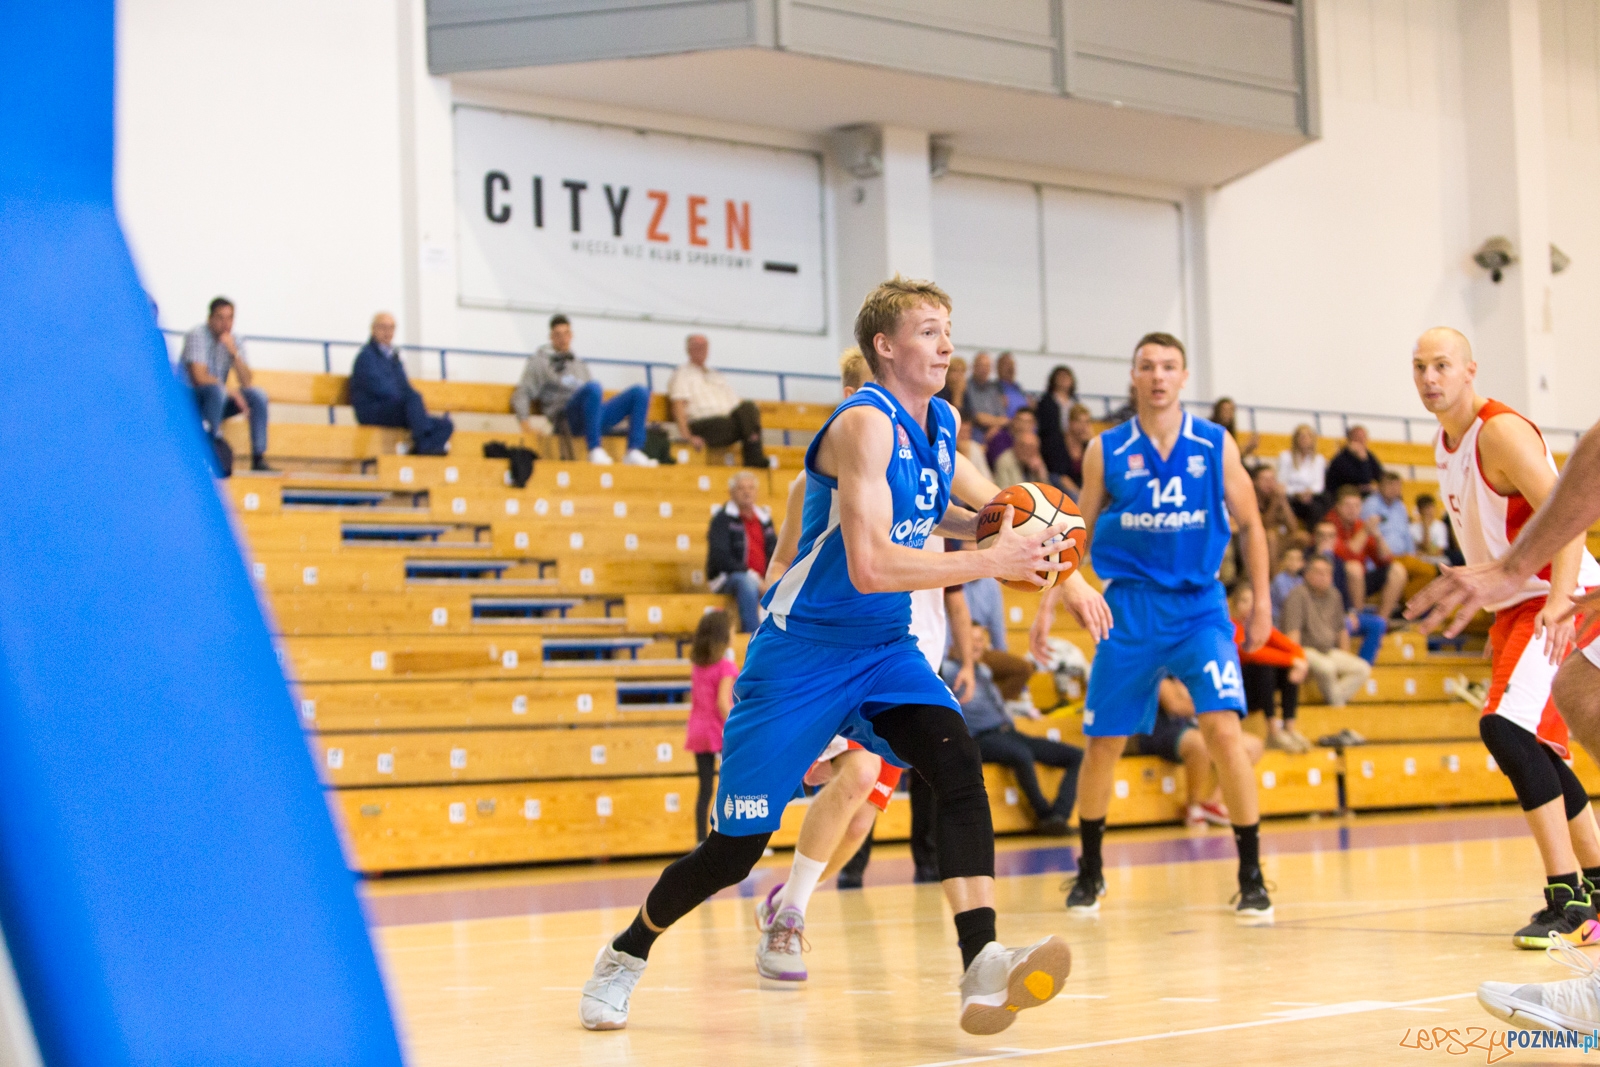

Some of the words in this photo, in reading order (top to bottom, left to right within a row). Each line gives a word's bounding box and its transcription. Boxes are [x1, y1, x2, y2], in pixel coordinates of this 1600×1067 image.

[483, 170, 752, 252] CITYZEN
[915, 468, 939, 510] 3
[1147, 476, 1187, 508] 14
[1203, 660, 1240, 690] 14
[735, 799, 769, 819] PBG
